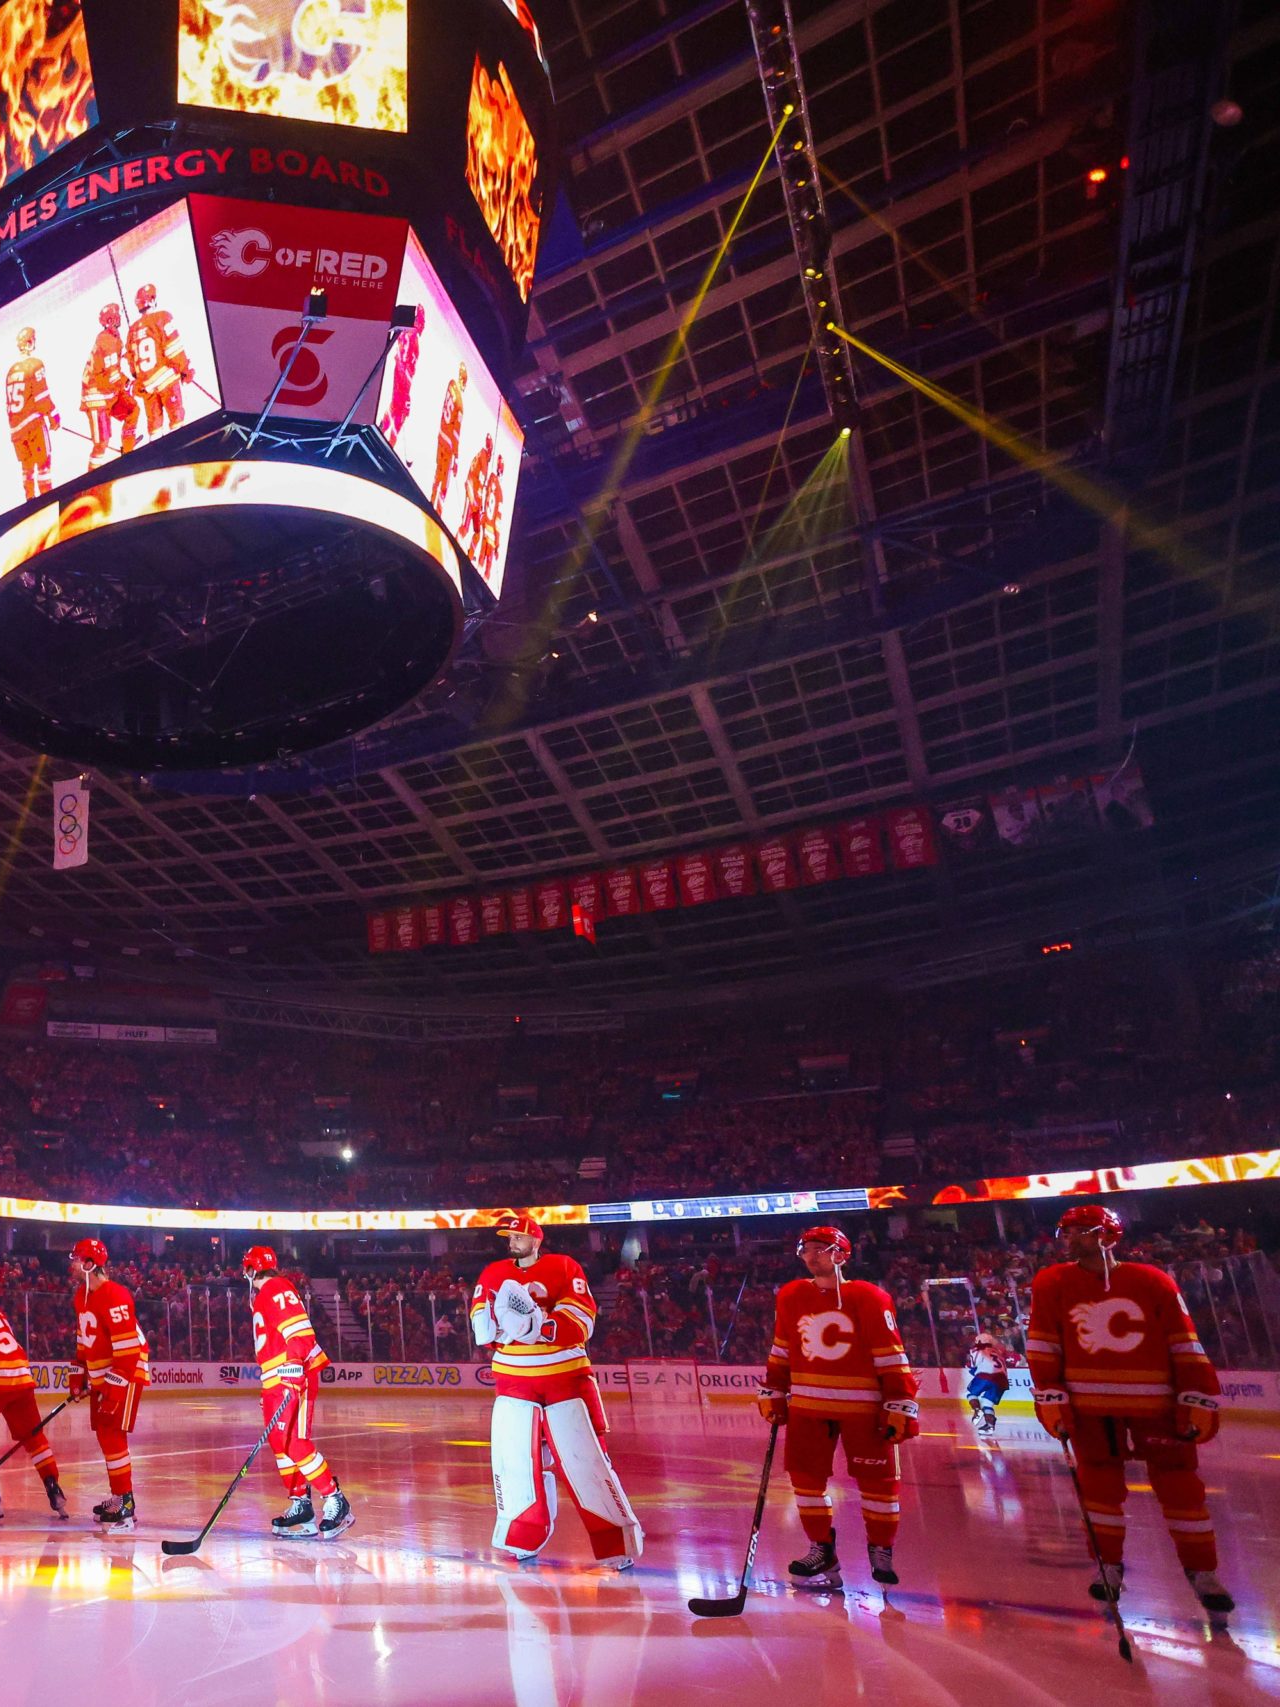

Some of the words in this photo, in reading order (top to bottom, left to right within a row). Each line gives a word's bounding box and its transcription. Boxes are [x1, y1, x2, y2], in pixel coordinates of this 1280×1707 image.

[66, 147, 234, 209] ENERGY
[250, 148, 389, 197] BOARD
[275, 248, 311, 267] OF
[315, 248, 388, 279] RED
[313, 275, 347, 286] LIVES
[353, 279, 384, 289] HERE
[272, 1290, 298, 1310] 73
[109, 1304, 130, 1323] 55
[152, 1368, 203, 1384] Scotiabank
[220, 1366, 240, 1379] SN
[374, 1365, 434, 1385] PIZZA
[436, 1366, 461, 1385] 73
[700, 1373, 766, 1388] ORIGIN
[1008, 1378, 1031, 1387] ELU
[1034, 1393, 1063, 1402] CM
[1221, 1384, 1264, 1401] upreme
[852, 1457, 888, 1465] CCM
